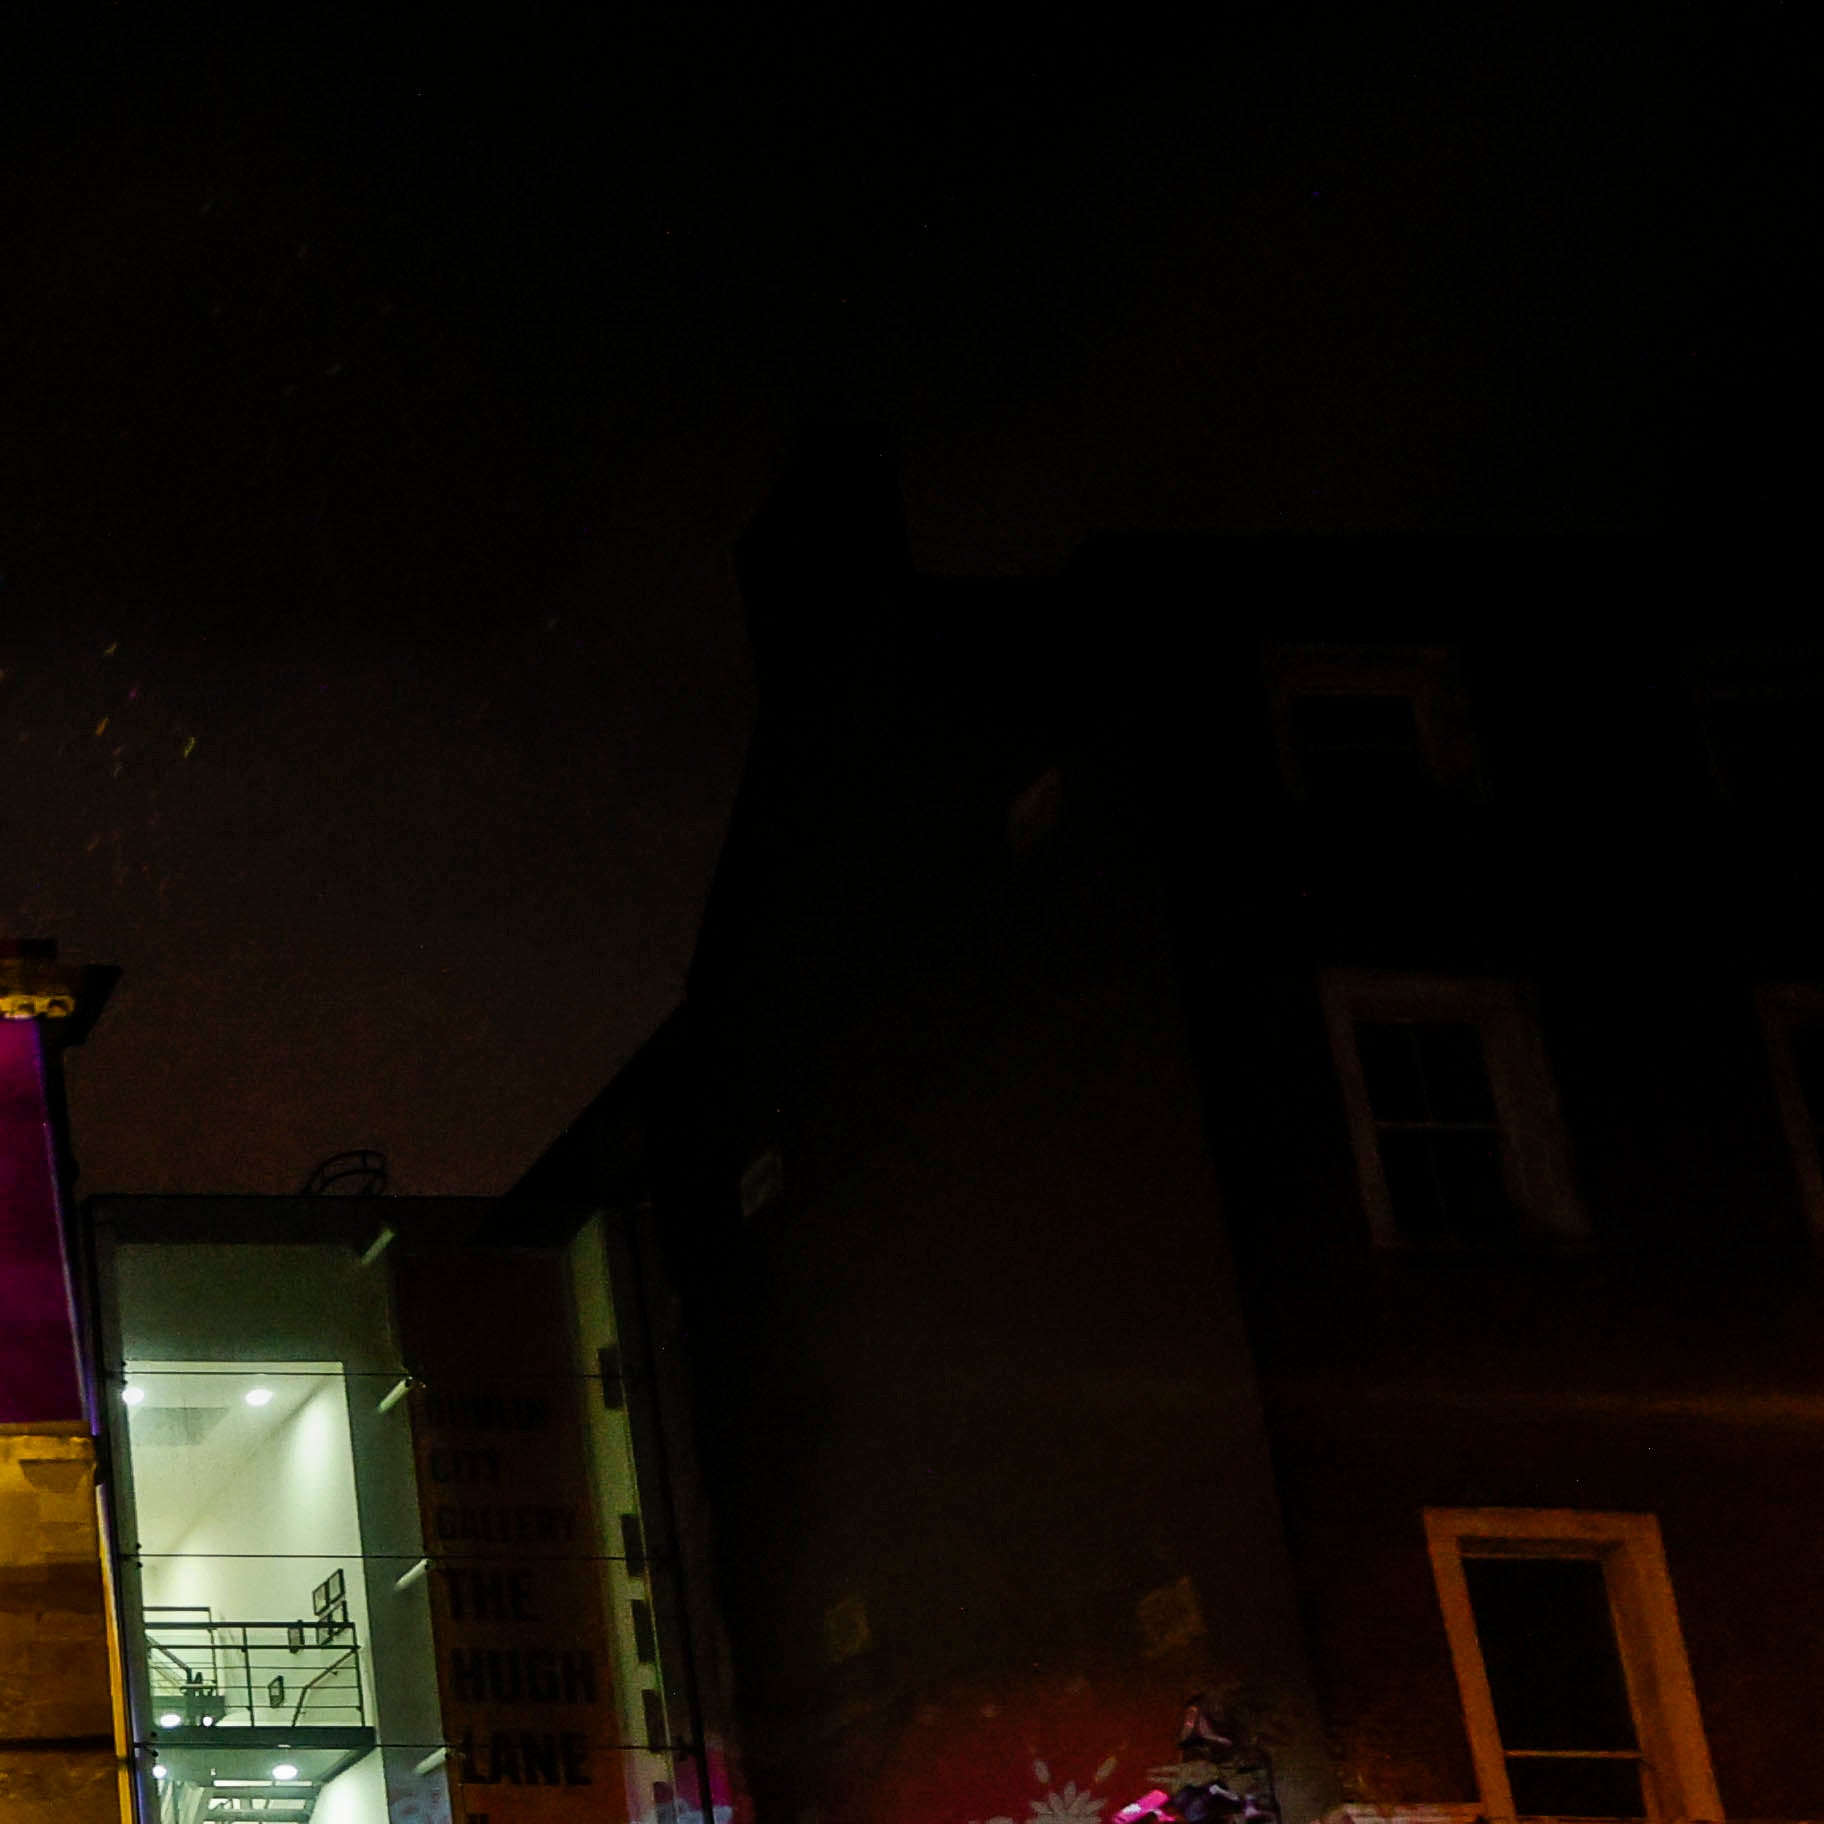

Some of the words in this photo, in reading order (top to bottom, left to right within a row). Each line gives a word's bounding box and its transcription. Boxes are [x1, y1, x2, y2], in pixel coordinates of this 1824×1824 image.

[436, 1505, 576, 1542] GALLERY
[444, 1567, 543, 1622] THE
[451, 1647, 596, 1704] HUGH
[461, 1727, 591, 1786] LANE
